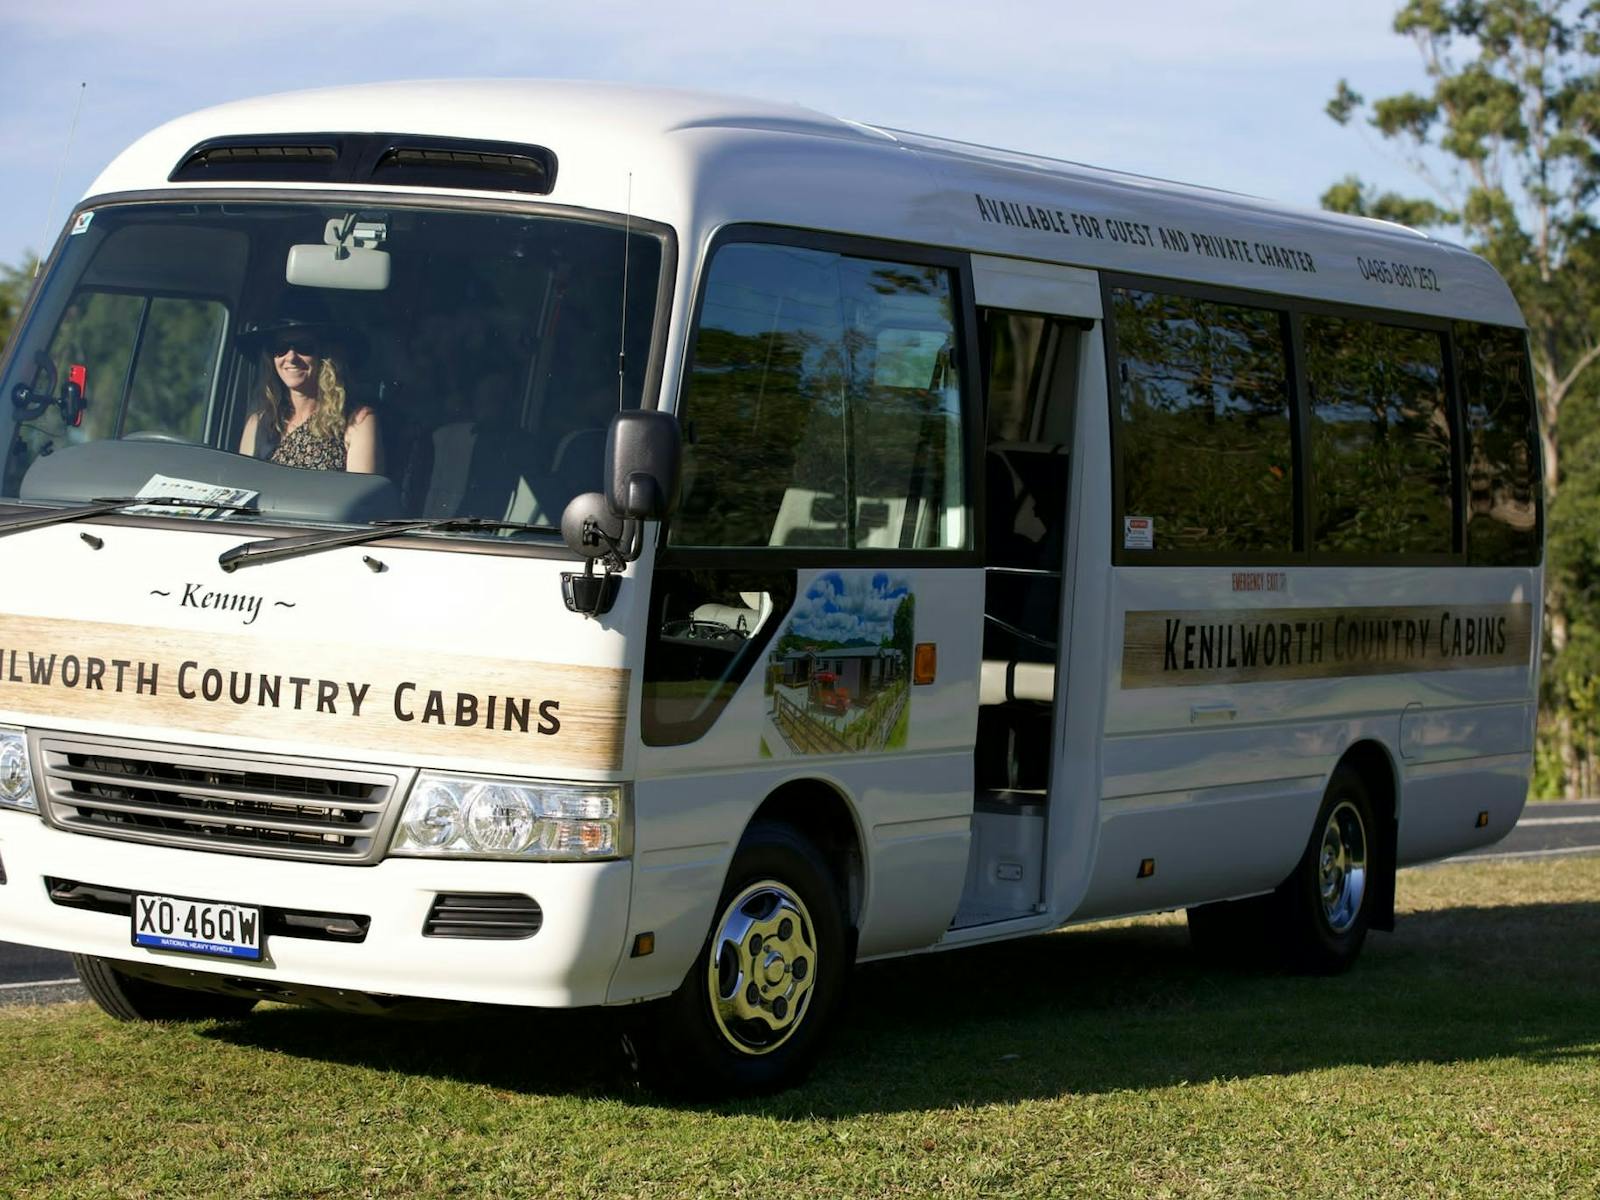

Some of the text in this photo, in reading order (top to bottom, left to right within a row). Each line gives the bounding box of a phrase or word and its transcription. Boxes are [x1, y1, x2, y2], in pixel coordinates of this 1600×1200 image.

[975, 194, 1318, 273] AVAILABLE FOR GUEST AND PRIVATE CHARTER
[1357, 256, 1393, 284] 0485
[1413, 266, 1441, 292] 252
[179, 583, 263, 625] Kenny
[1163, 612, 1508, 672] KENILWORTH COUNTRY CABINS
[178, 660, 370, 717] COUNTRY
[394, 682, 562, 736] CABINS
[161, 939, 233, 953] NATIONAL HEAVY VEHICLE
